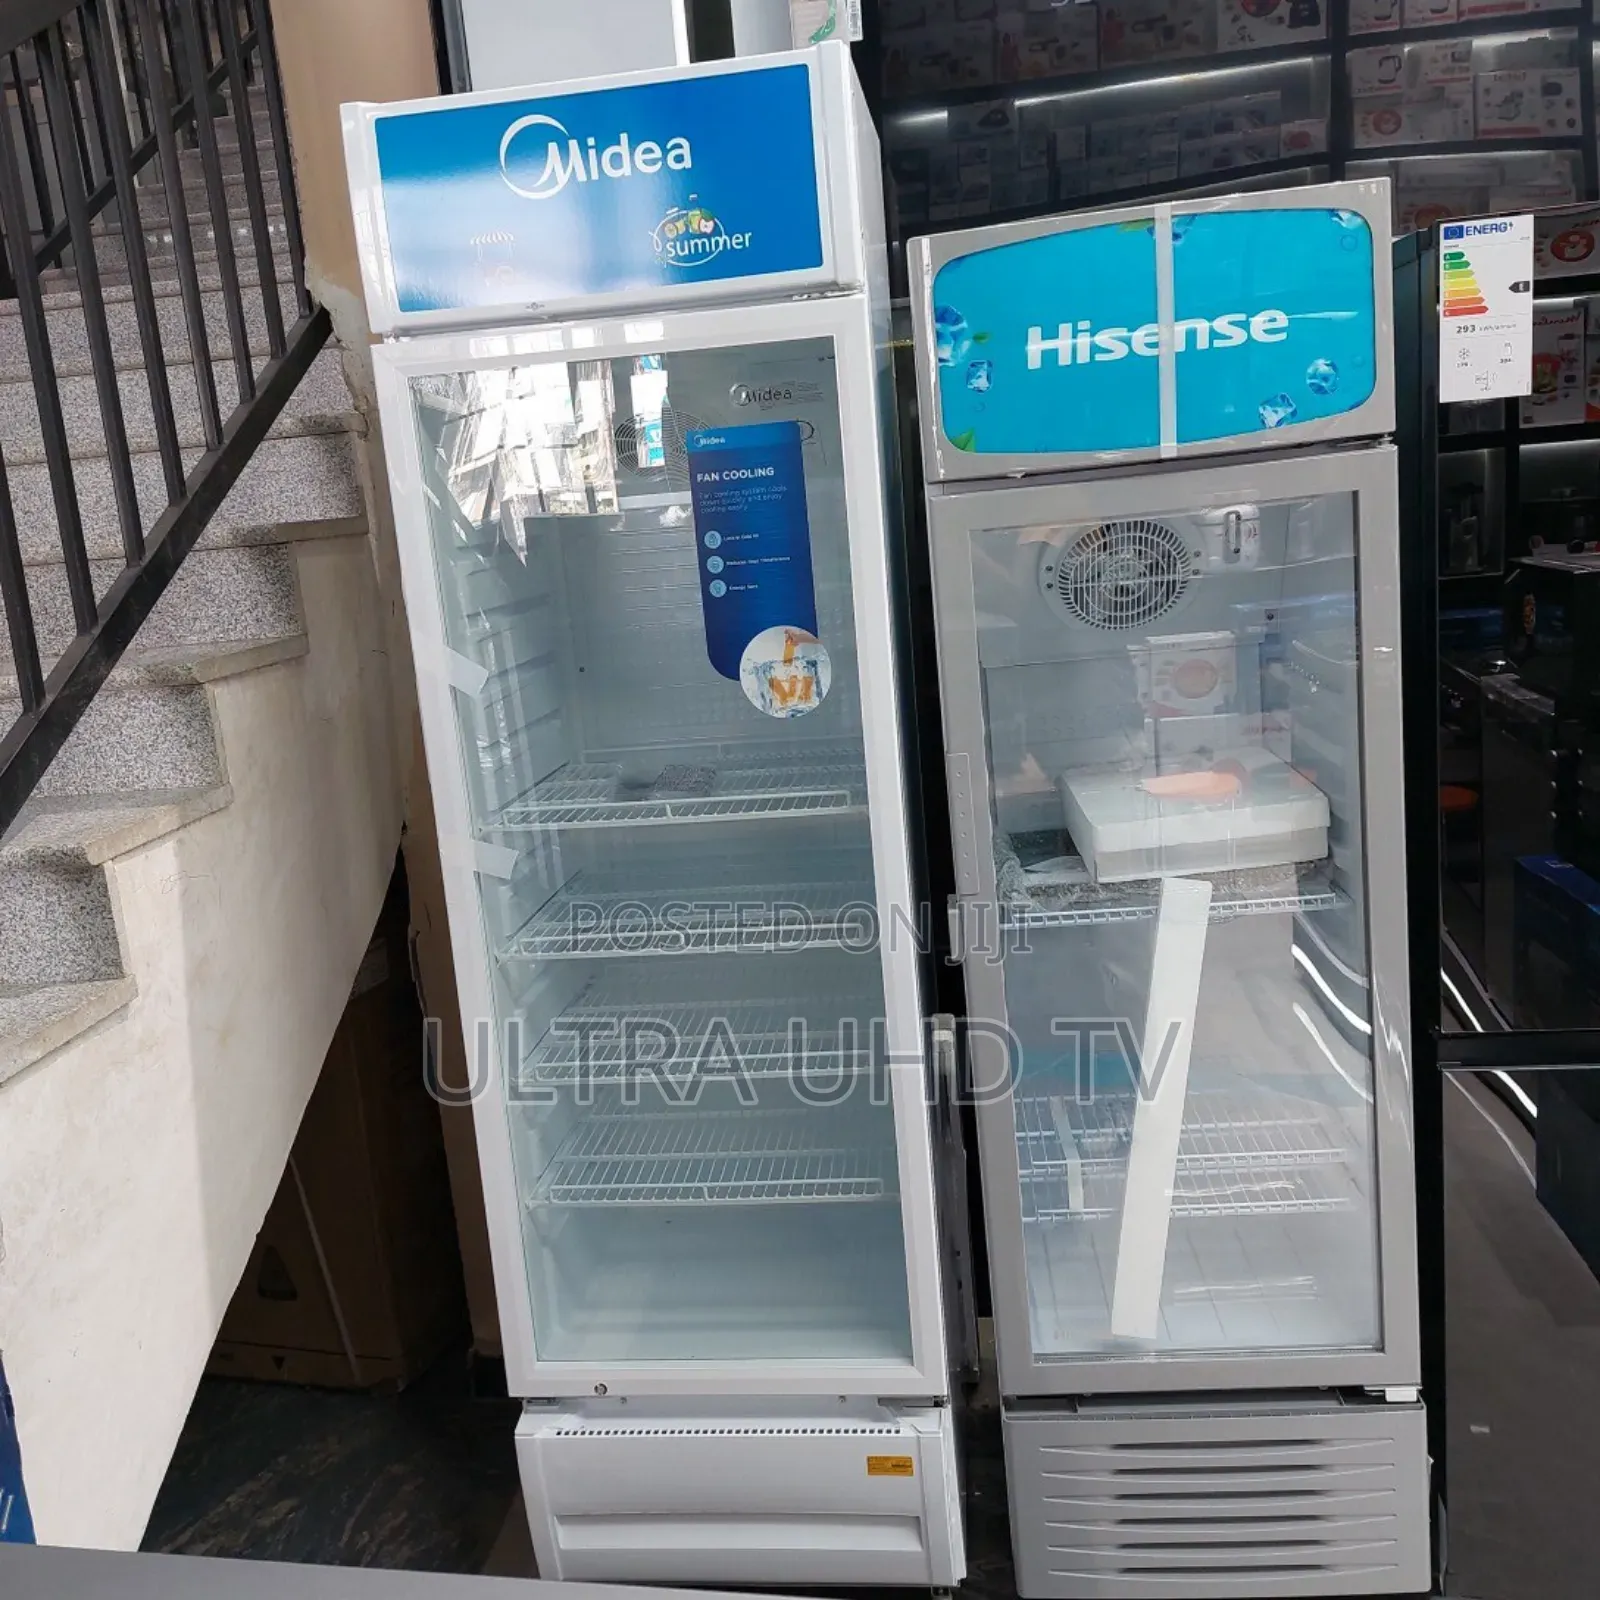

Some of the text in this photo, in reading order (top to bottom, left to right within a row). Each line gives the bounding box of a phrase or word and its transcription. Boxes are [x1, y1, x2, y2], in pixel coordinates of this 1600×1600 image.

[499, 114, 692, 199] Midea
[1465, 222, 1508, 236] ENERG
[666, 231, 752, 258] summer
[1027, 309, 1289, 370] Hisense
[1456, 325, 1476, 334] 293
[729, 383, 793, 407] Midea
[693, 434, 726, 447] Midea
[697, 466, 775, 483] FAN COOLING
